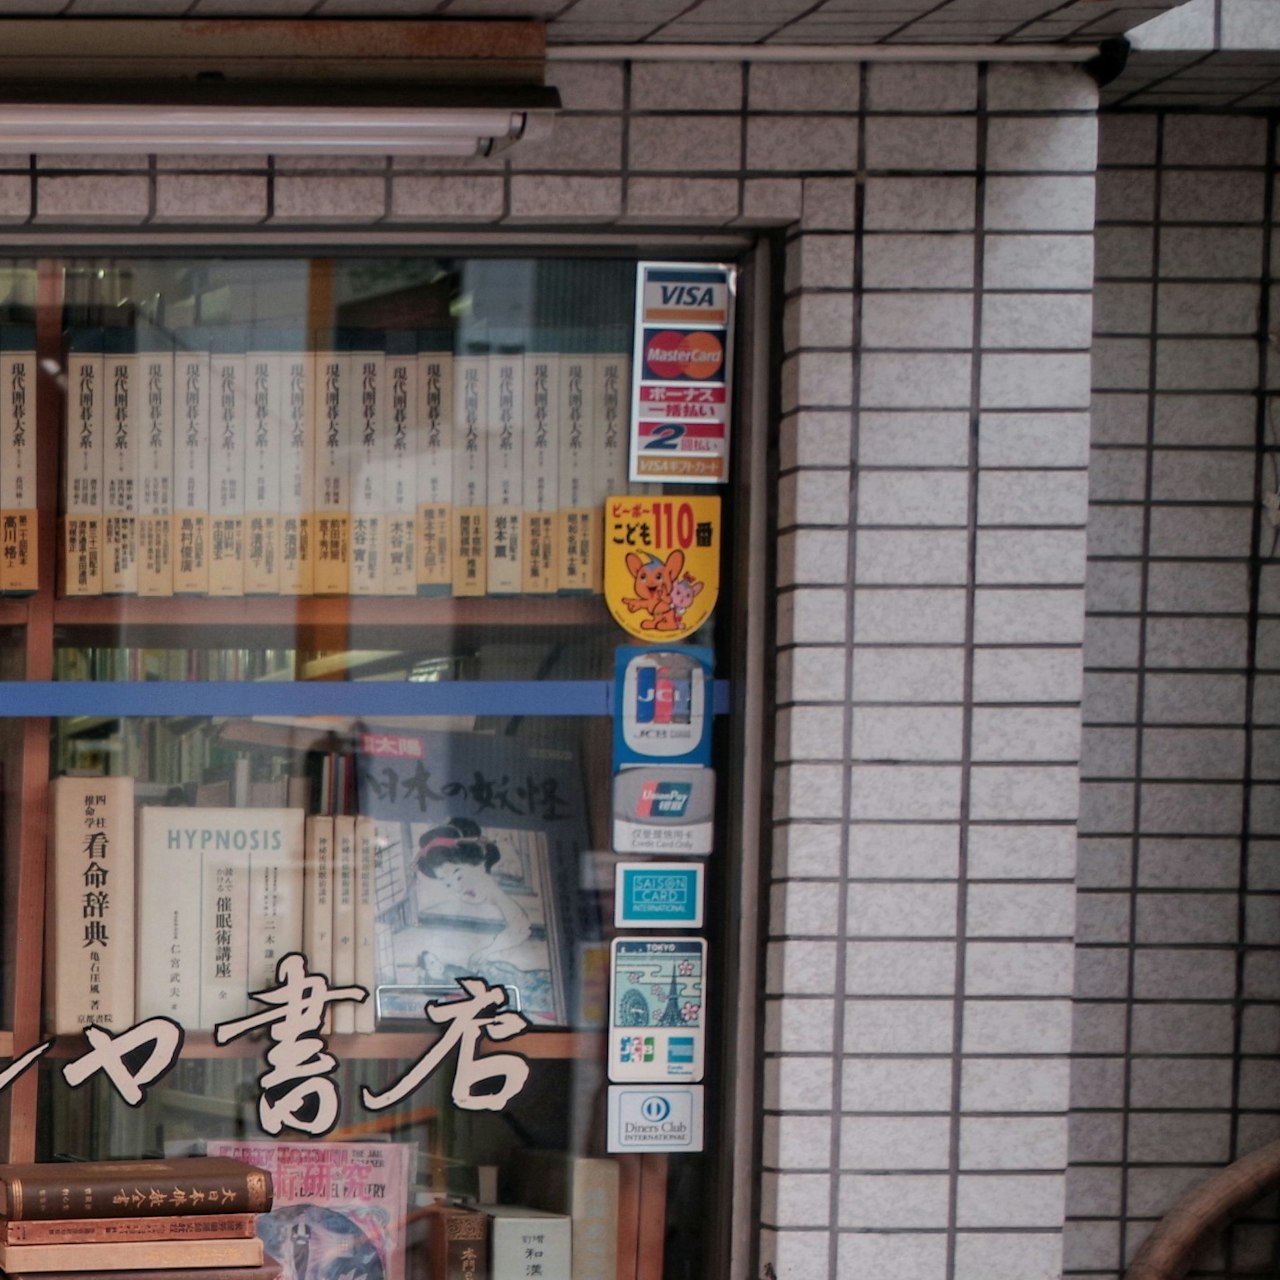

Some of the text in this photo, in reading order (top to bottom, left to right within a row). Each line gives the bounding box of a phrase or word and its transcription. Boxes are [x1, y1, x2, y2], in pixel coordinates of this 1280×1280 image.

[660, 285, 715, 308] VISA
[647, 347, 721, 364] MasterCard
[649, 387, 715, 402] ボーナス
[168, 829, 282, 849] HYPNOSIS
[642, 890, 679, 902] CARD
[646, 943, 676, 953] TOKYO
[624, 1122, 687, 1134] Diners Club
